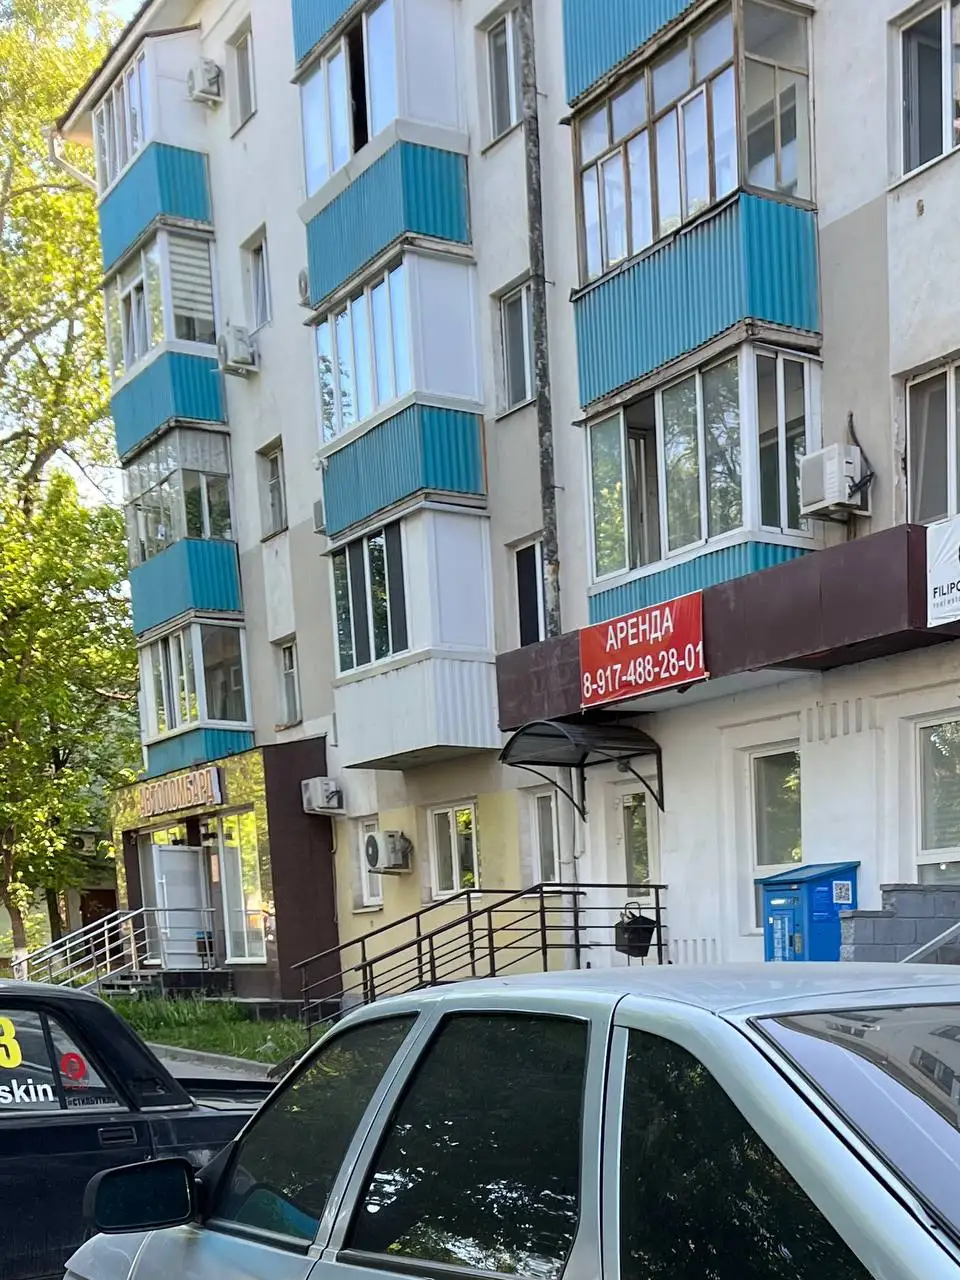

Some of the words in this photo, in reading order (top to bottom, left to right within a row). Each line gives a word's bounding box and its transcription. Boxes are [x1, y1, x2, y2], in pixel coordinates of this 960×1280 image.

[606, 607, 674, 652] АРЕНДА
[583, 641, 704, 698] 8-917-488-28-01
[140, 767, 220, 817] АВТОЛОМБАРД
